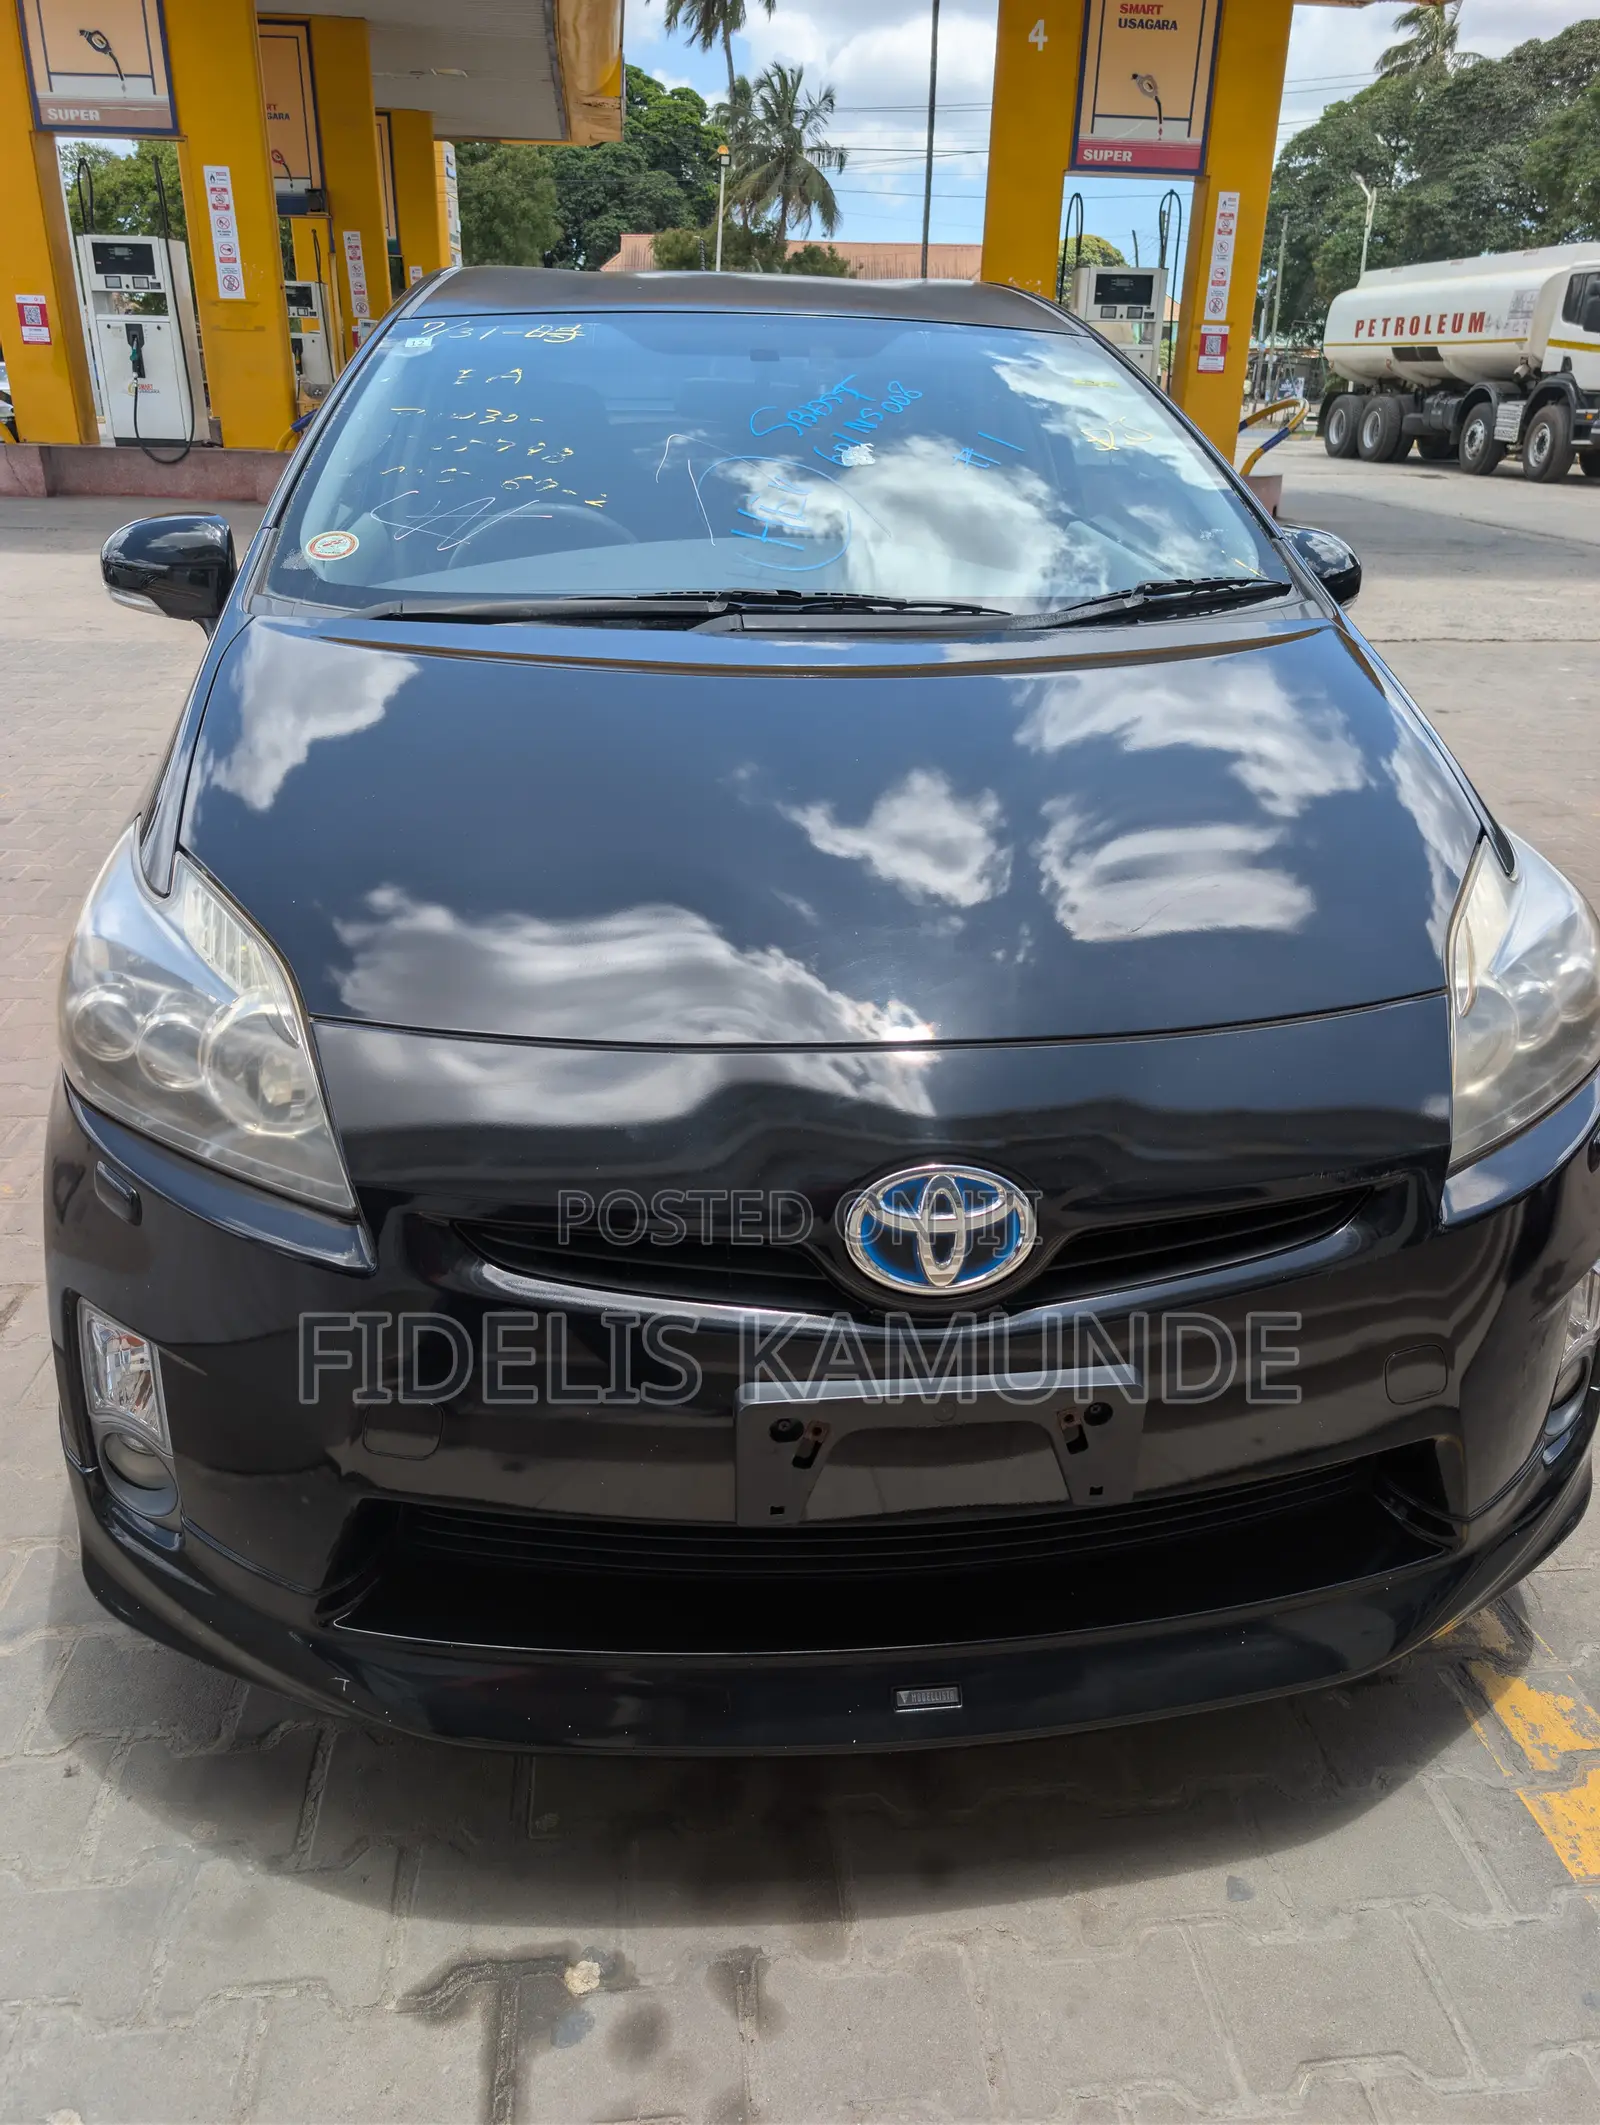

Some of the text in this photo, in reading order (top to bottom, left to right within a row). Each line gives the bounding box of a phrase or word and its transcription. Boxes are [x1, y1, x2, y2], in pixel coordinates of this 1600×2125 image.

[1119, 3, 1164, 16] SMART
[1117, 17, 1179, 31] USAGARA
[1028, 19, 1049, 51] 4
[46, 108, 101, 121] SUPER
[1082, 148, 1133, 164] SUPER
[1354, 311, 1486, 338] PETROLEUM
